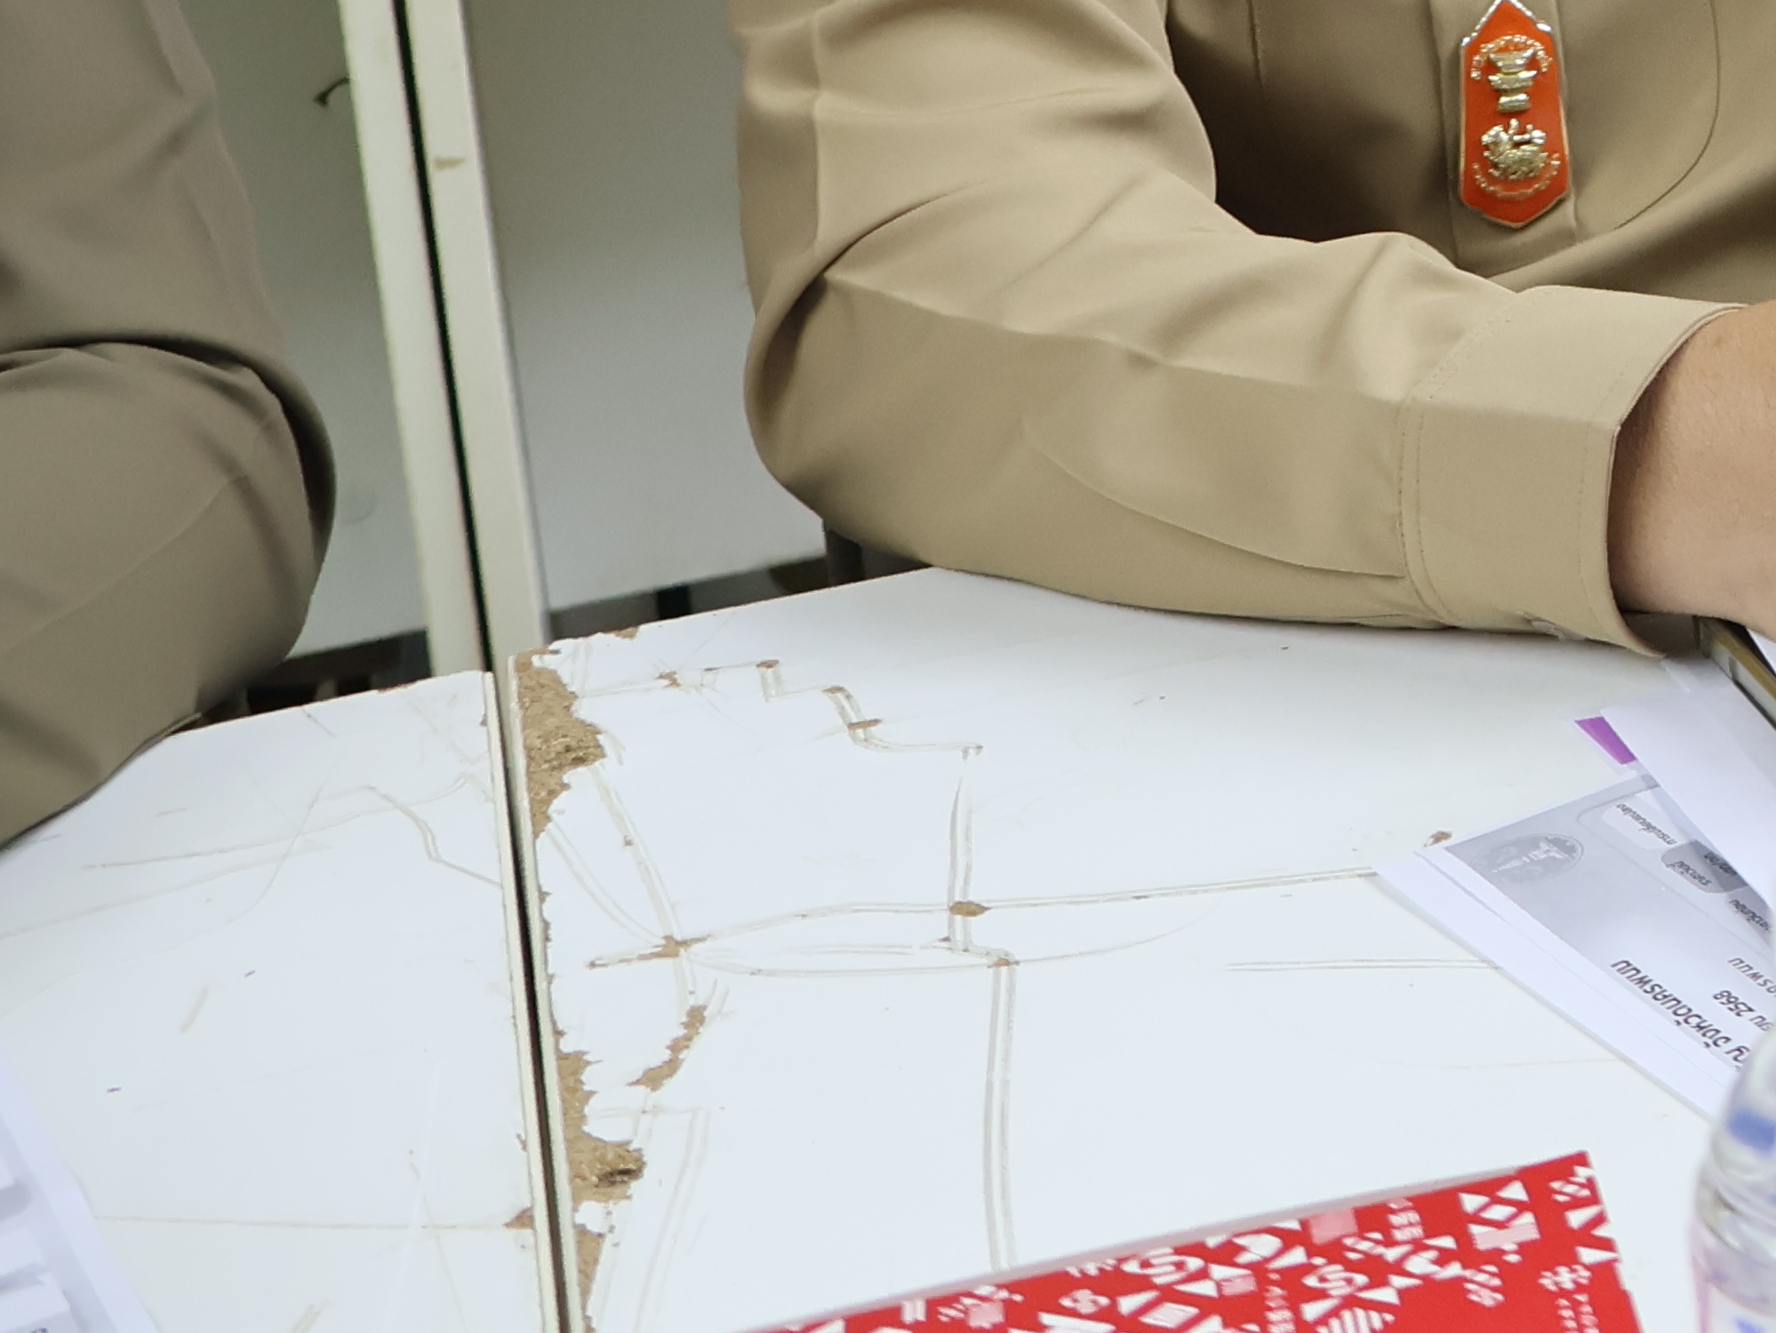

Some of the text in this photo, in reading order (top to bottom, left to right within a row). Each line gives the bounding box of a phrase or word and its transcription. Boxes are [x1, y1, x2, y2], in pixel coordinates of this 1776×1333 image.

[1610, 956, 1731, 1049] จังหวัดนครพนม
[1712, 987, 1754, 1017] 2568
